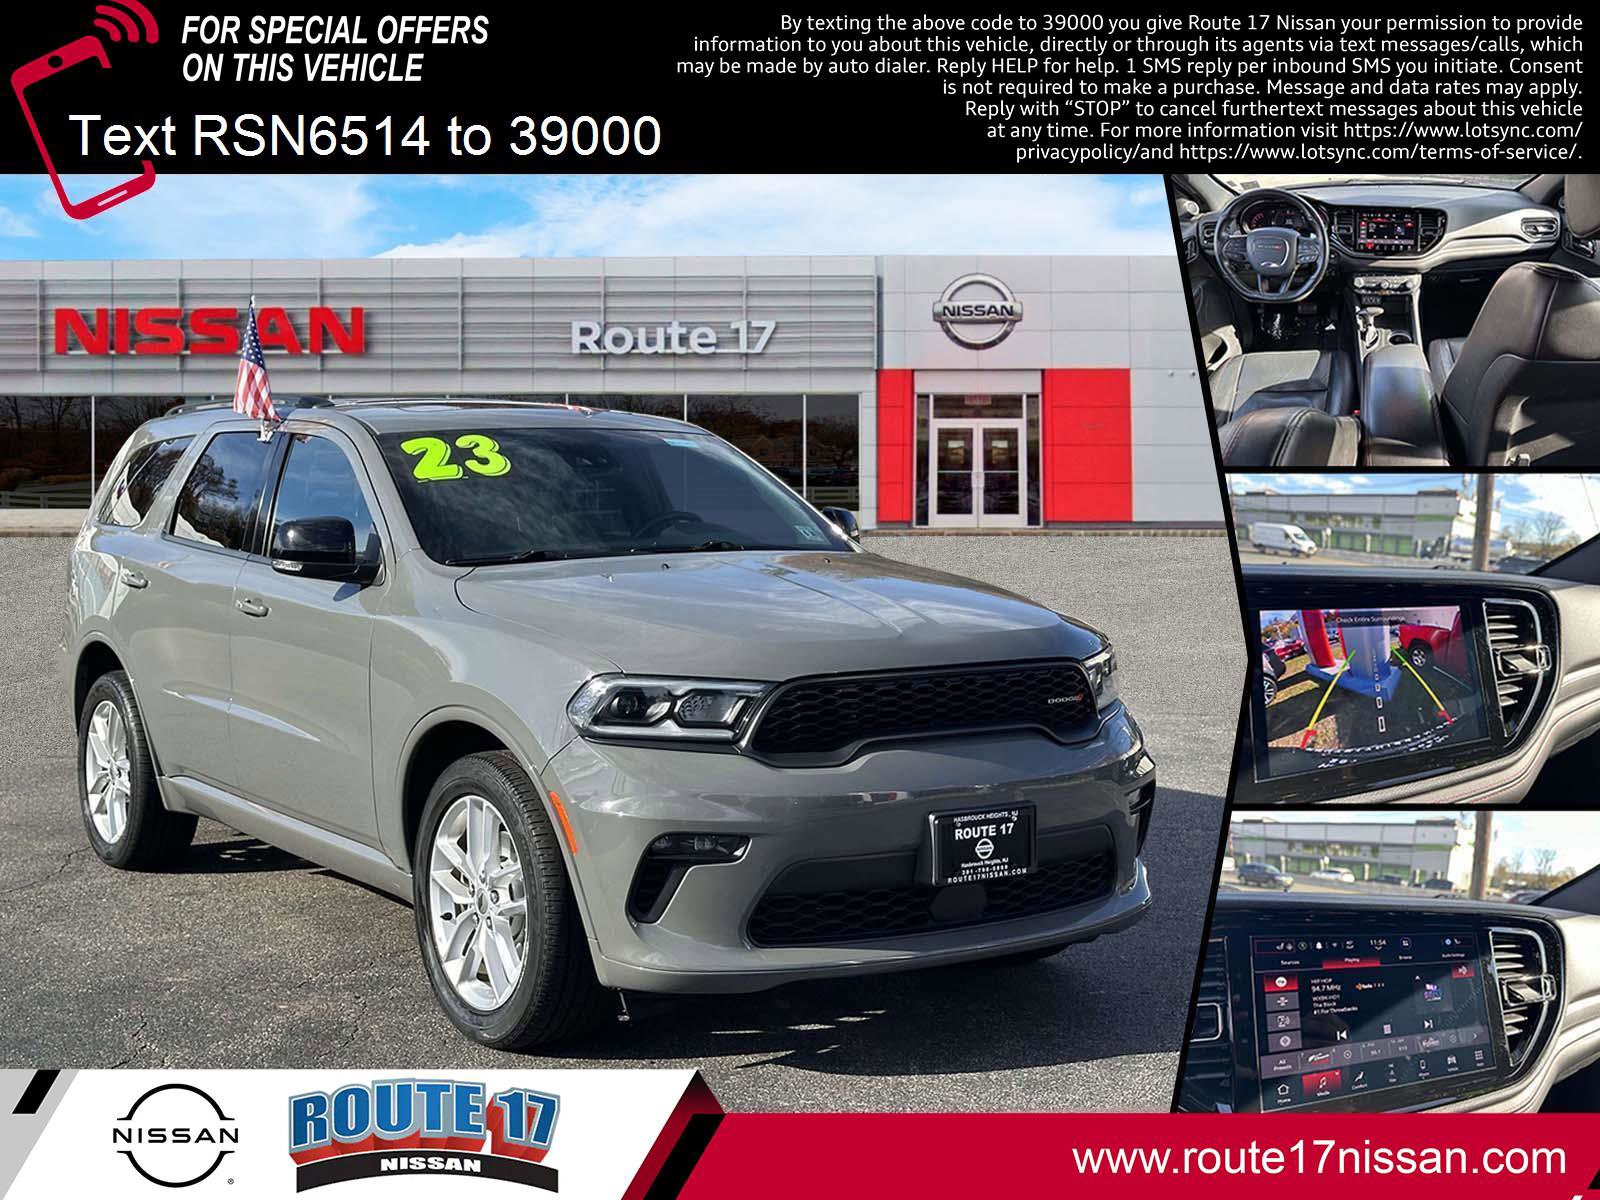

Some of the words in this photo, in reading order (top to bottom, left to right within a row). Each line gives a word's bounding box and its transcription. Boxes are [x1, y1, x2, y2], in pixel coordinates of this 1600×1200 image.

[942, 305, 1014, 317] NISSAN
[54, 307, 365, 355] NISSAN
[571, 320, 717, 354] Route
[730, 320, 777, 354] 17
[400, 434, 511, 482] 23
[955, 824, 997, 840] ROUTE
[1000, 822, 1014, 835] 17
